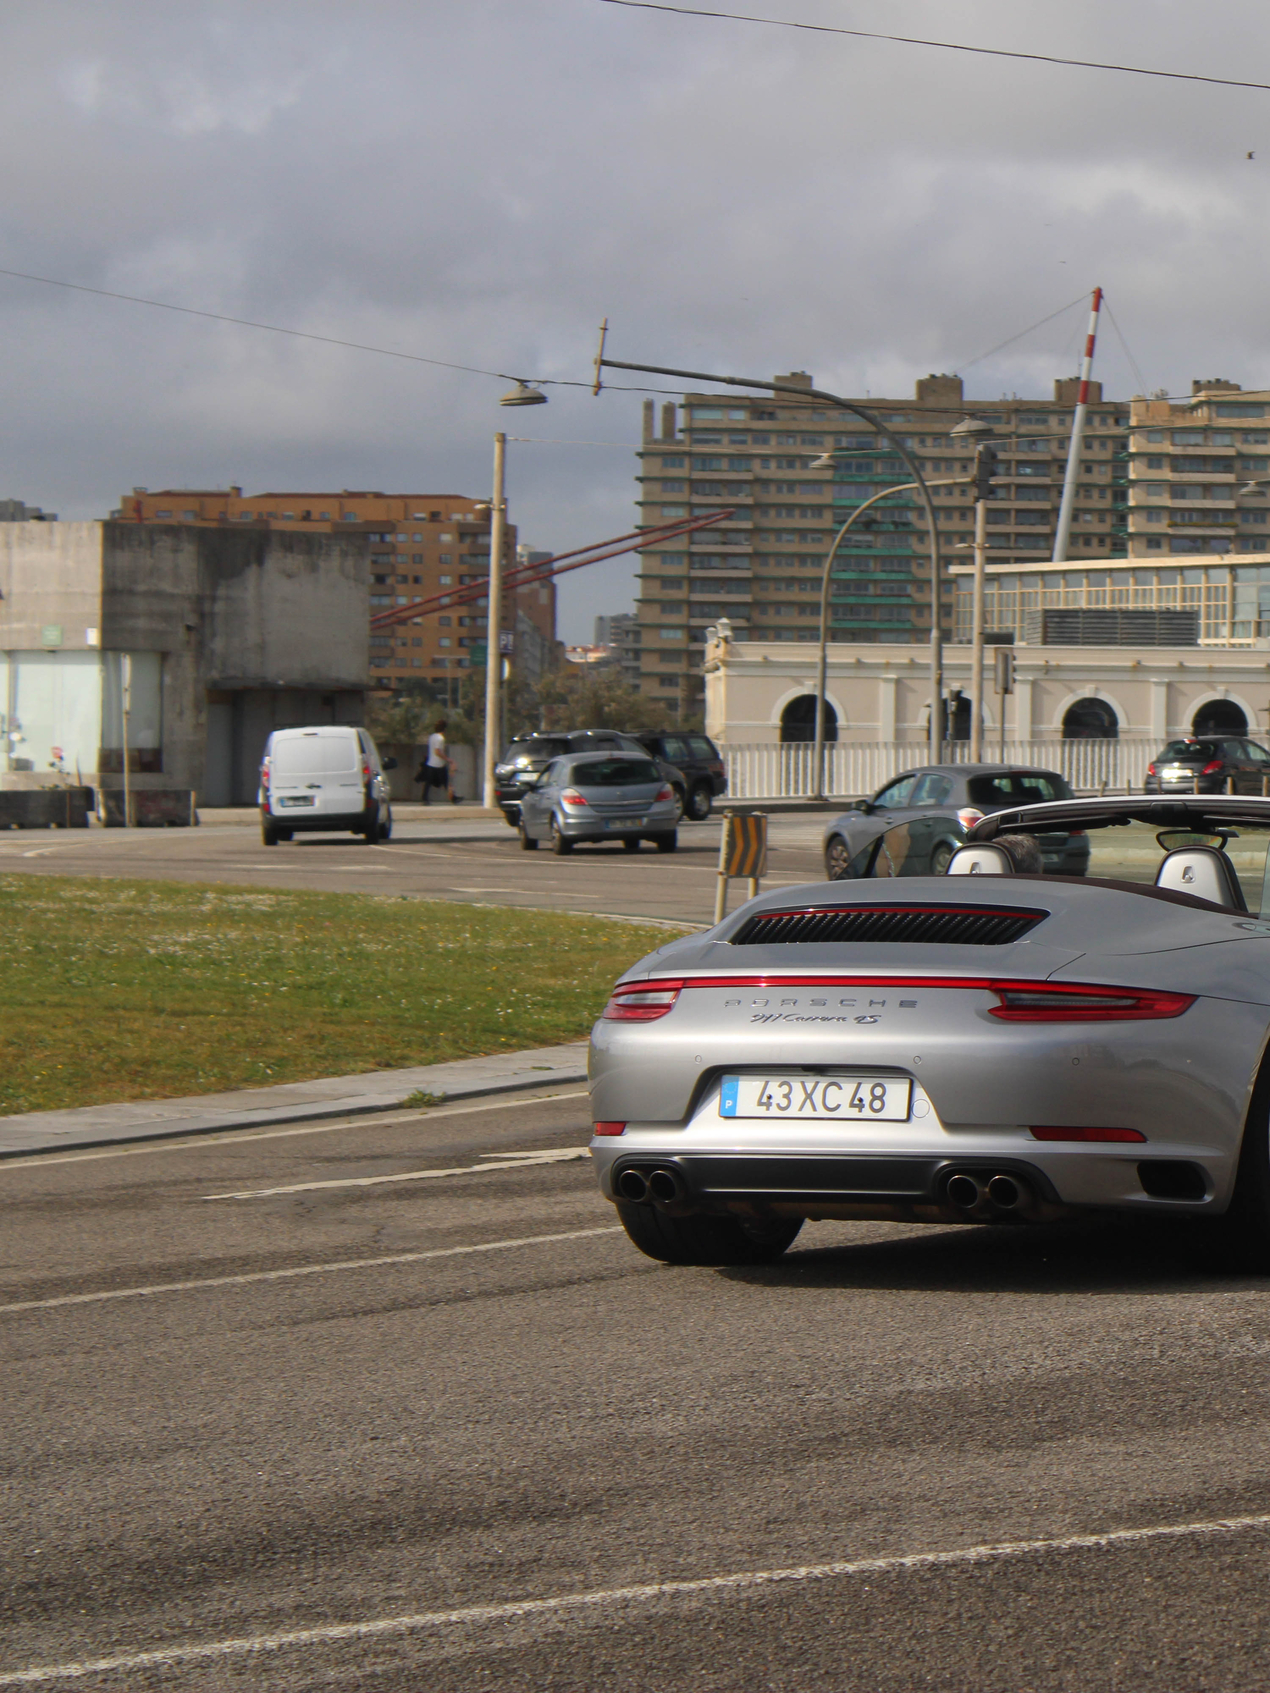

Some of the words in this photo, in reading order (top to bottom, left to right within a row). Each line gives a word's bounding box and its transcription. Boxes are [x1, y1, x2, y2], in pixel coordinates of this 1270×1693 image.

[724, 998, 918, 1009] PORSCHE
[750, 1013, 782, 1024] 911
[782, 1013, 848, 1023] Carrera
[853, 1014, 882, 1025] 4S
[725, 1100, 733, 1109] P
